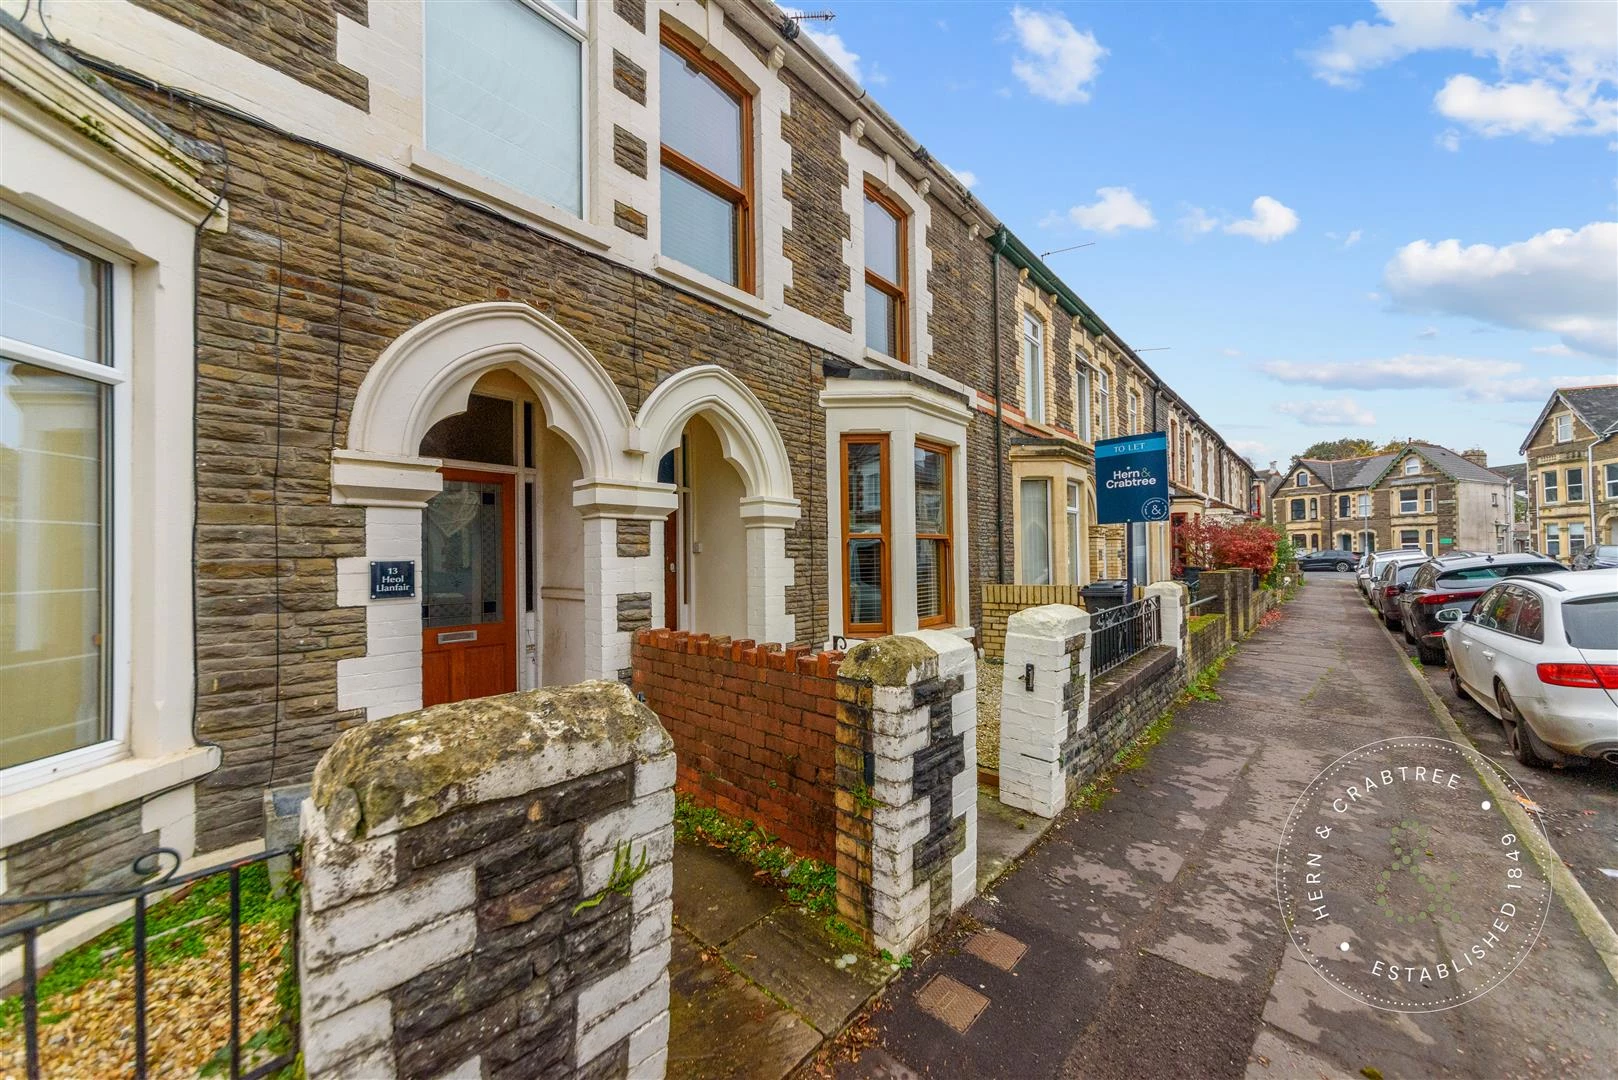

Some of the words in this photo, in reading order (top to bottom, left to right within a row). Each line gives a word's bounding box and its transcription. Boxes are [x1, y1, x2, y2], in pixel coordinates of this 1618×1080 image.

[1113, 445, 1126, 453] TO
[1128, 442, 1146, 451] LET
[1105, 477, 1157, 489] Crabtree
[387, 567, 399, 575] 13
[381, 575, 405, 584] Heol
[375, 583, 411, 592] Llanfair
